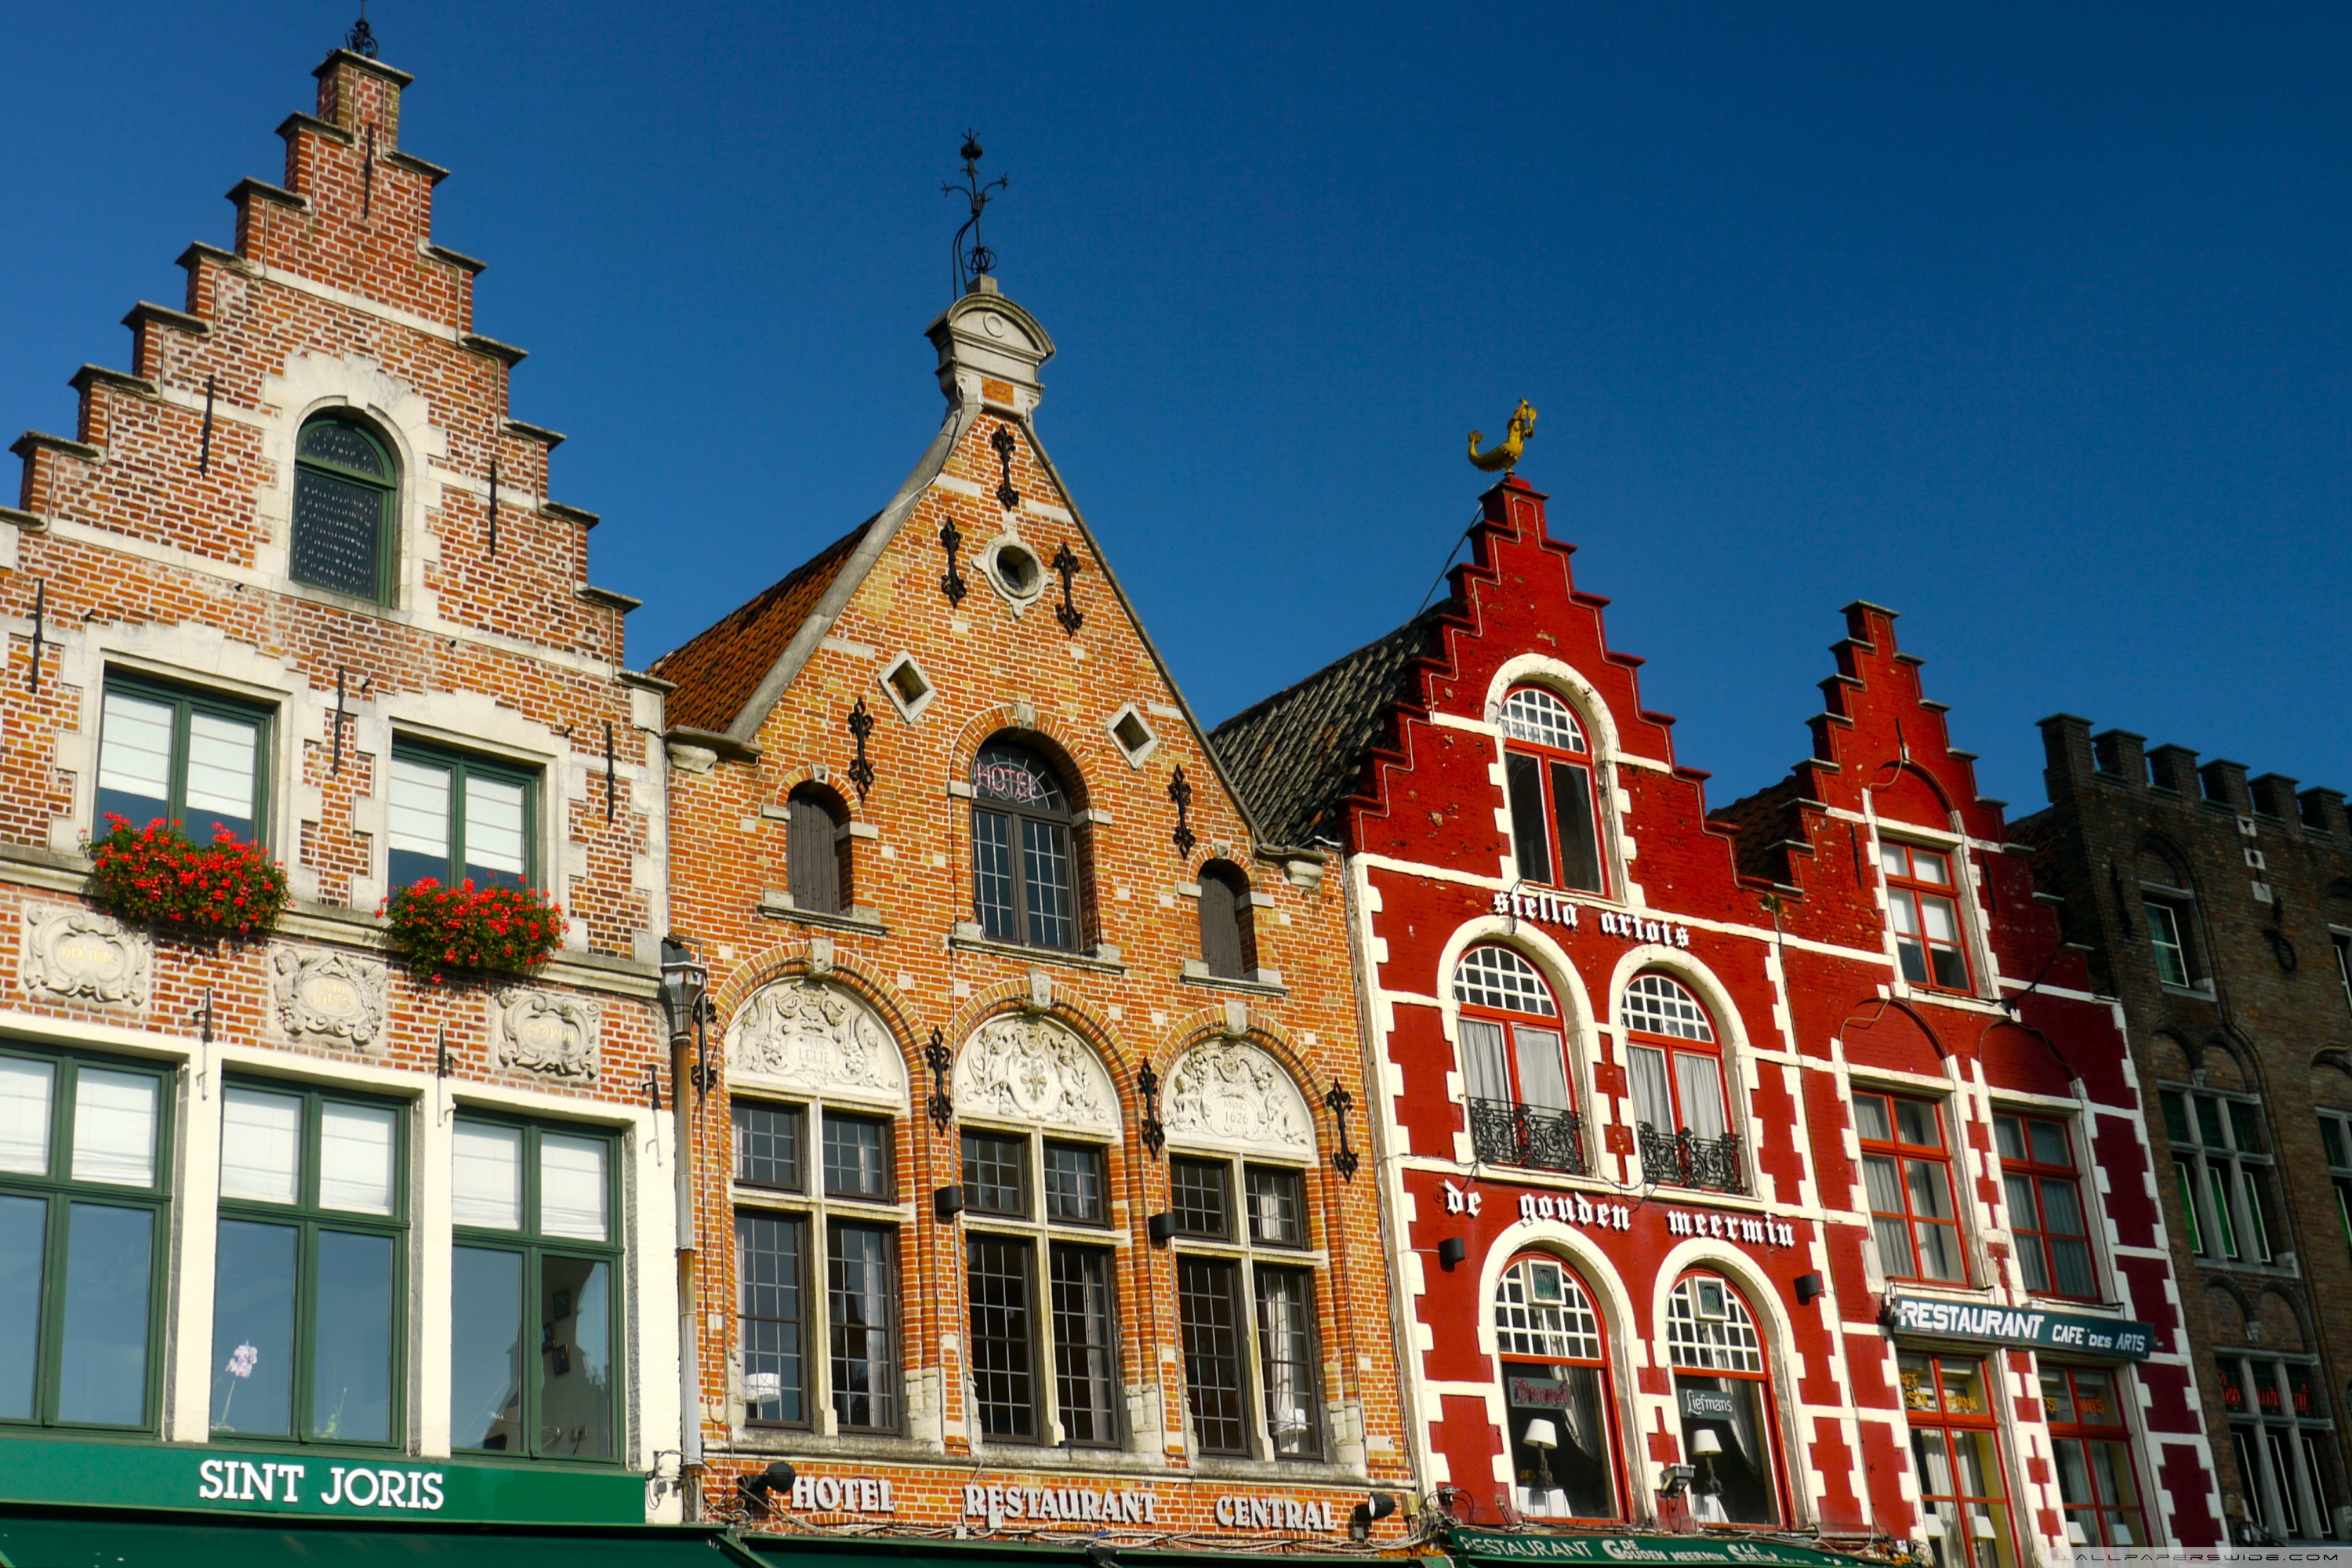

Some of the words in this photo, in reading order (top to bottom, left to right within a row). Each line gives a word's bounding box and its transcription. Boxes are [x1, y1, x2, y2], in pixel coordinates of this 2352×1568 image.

[976, 763, 1040, 800] HOTEL
[1493, 890, 1579, 927] stella
[1601, 910, 1690, 948] artois
[1224, 1100, 1247, 1111] ANNO
[1225, 1112, 1248, 1124] 1626
[1444, 1179, 1482, 1217] de
[1519, 1191, 1631, 1231] gouden
[1667, 1210, 1795, 1247] meermin
[1900, 1300, 2045, 1340] RESTAURANT
[2089, 1334, 2112, 1349] DES
[2116, 1332, 2146, 1352] ARTS
[1686, 1389, 1733, 1415] Liefmans
[199, 1459, 304, 1503] SINT
[321, 1467, 445, 1511] JORIS
[790, 1475, 897, 1512] HOTEL
[964, 1483, 1157, 1524] RESTAURANT
[1214, 1494, 1338, 1530] CENTRAL
[1459, 1535, 1594, 1558] RESTAURANT
[1602, 1540, 1668, 1562] GOUDEN
[1669, 1551, 1729, 1562] MEERMIN
[1620, 1540, 1639, 1551] DE
